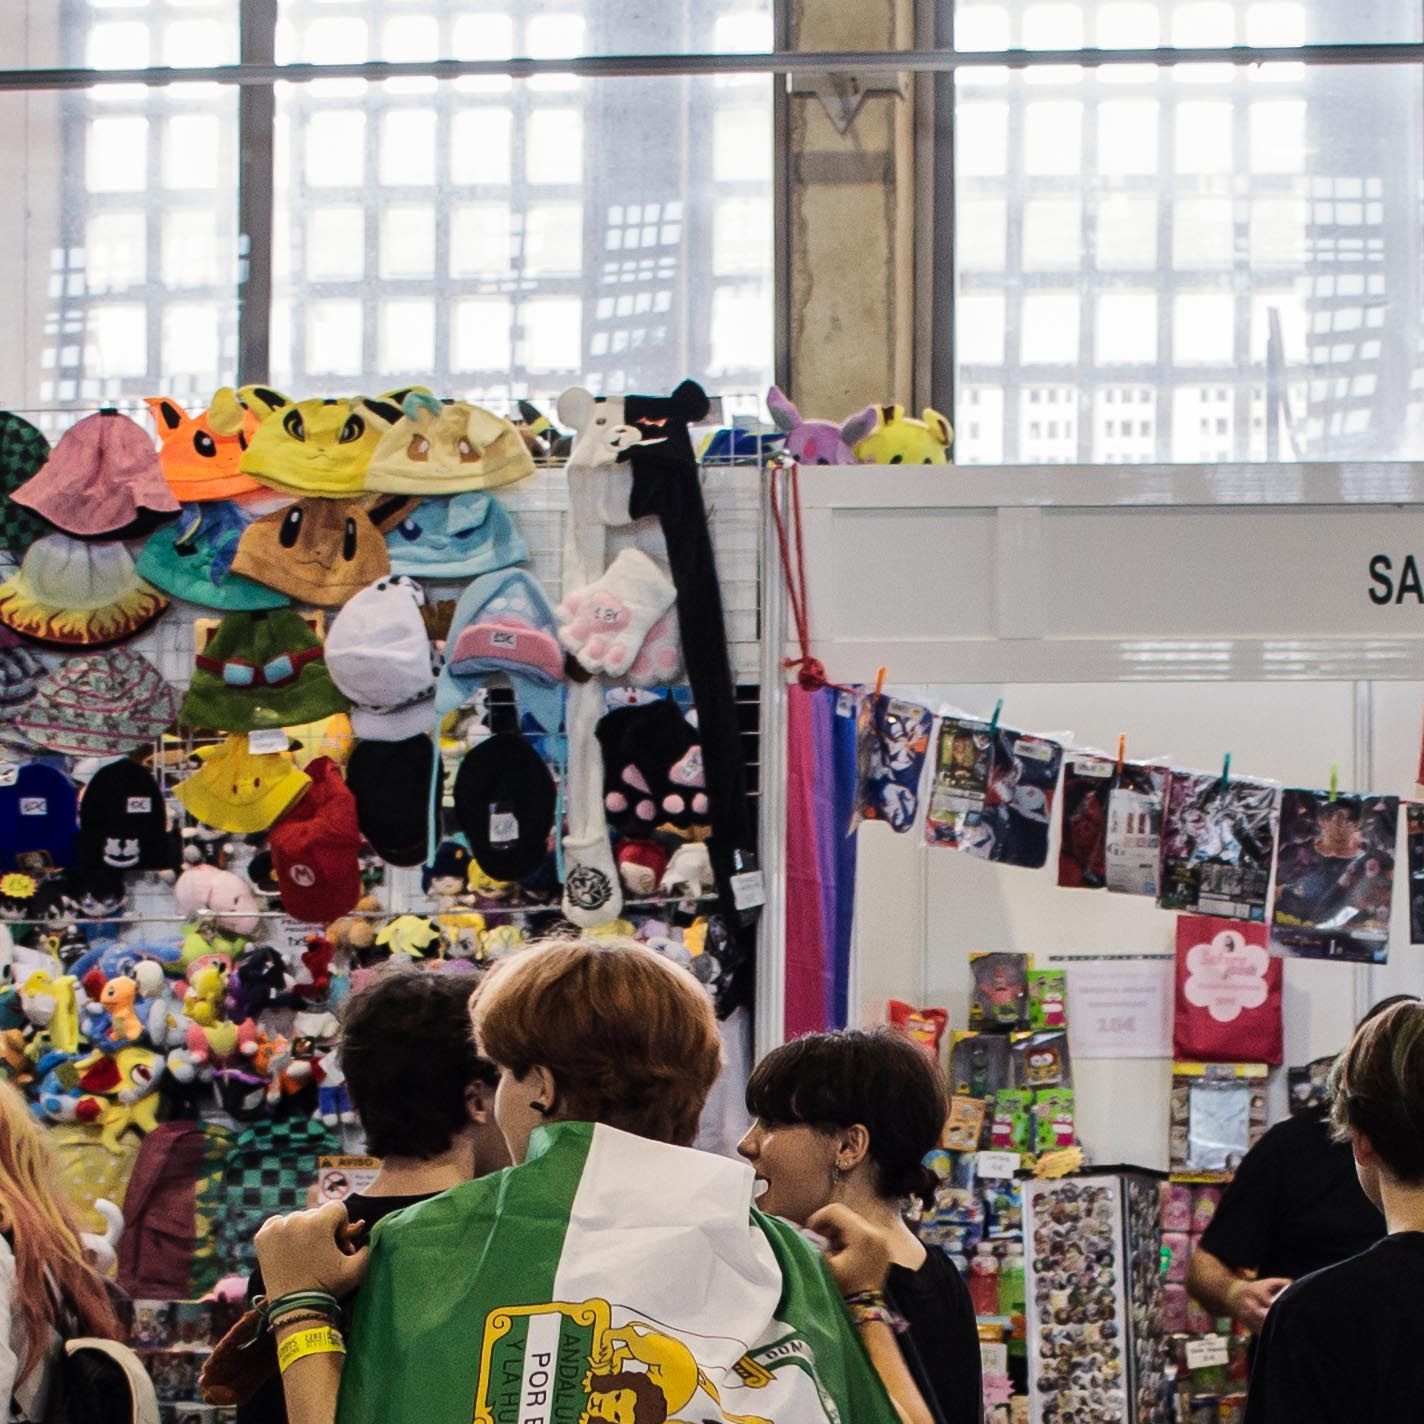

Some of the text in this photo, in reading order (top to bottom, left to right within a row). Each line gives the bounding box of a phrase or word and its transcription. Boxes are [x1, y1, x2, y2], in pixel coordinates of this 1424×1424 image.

[293, 866, 313, 885] M
[505, 1338, 524, 1351] Y
[502, 1359, 522, 1386] LA
[526, 1352, 551, 1407] POR
